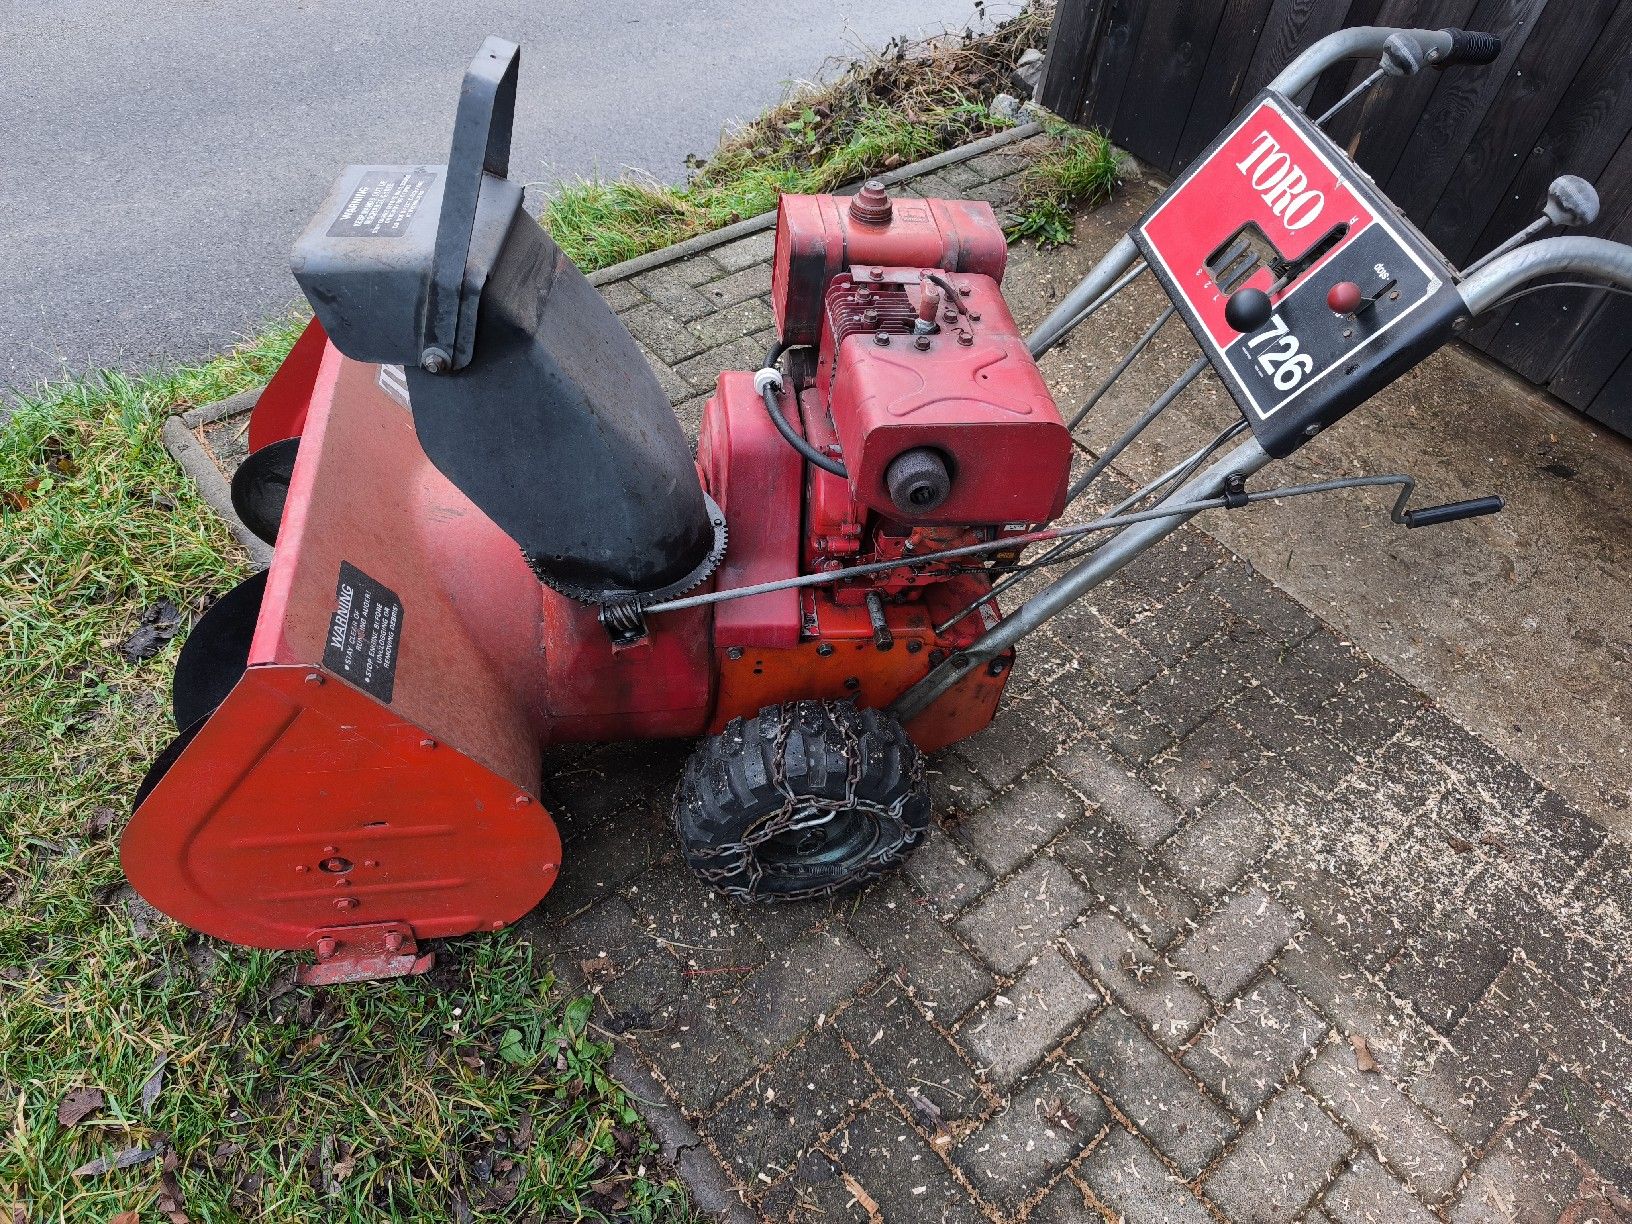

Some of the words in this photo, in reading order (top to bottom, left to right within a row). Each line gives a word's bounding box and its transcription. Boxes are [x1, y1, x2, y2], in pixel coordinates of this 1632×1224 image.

[340, 186, 370, 219] WARNING
[1236, 131, 1325, 230] TORO
[1248, 313, 1314, 391] 726
[331, 583, 353, 651] WARNING
[345, 646, 353, 665] STAY
[349, 620, 357, 644] CLEAR
[354, 609, 360, 620] OF
[355, 618, 367, 652] RUNING
[362, 590, 371, 617] AUGER!
[368, 630, 378, 657] ENGINE
[374, 603, 383, 630] BEFORE
[376, 617, 388, 664] UNCLOGGING
[383, 607, 390, 617] OR
[365, 657, 373, 677] STOP
[384, 631, 394, 668] REMOVING
